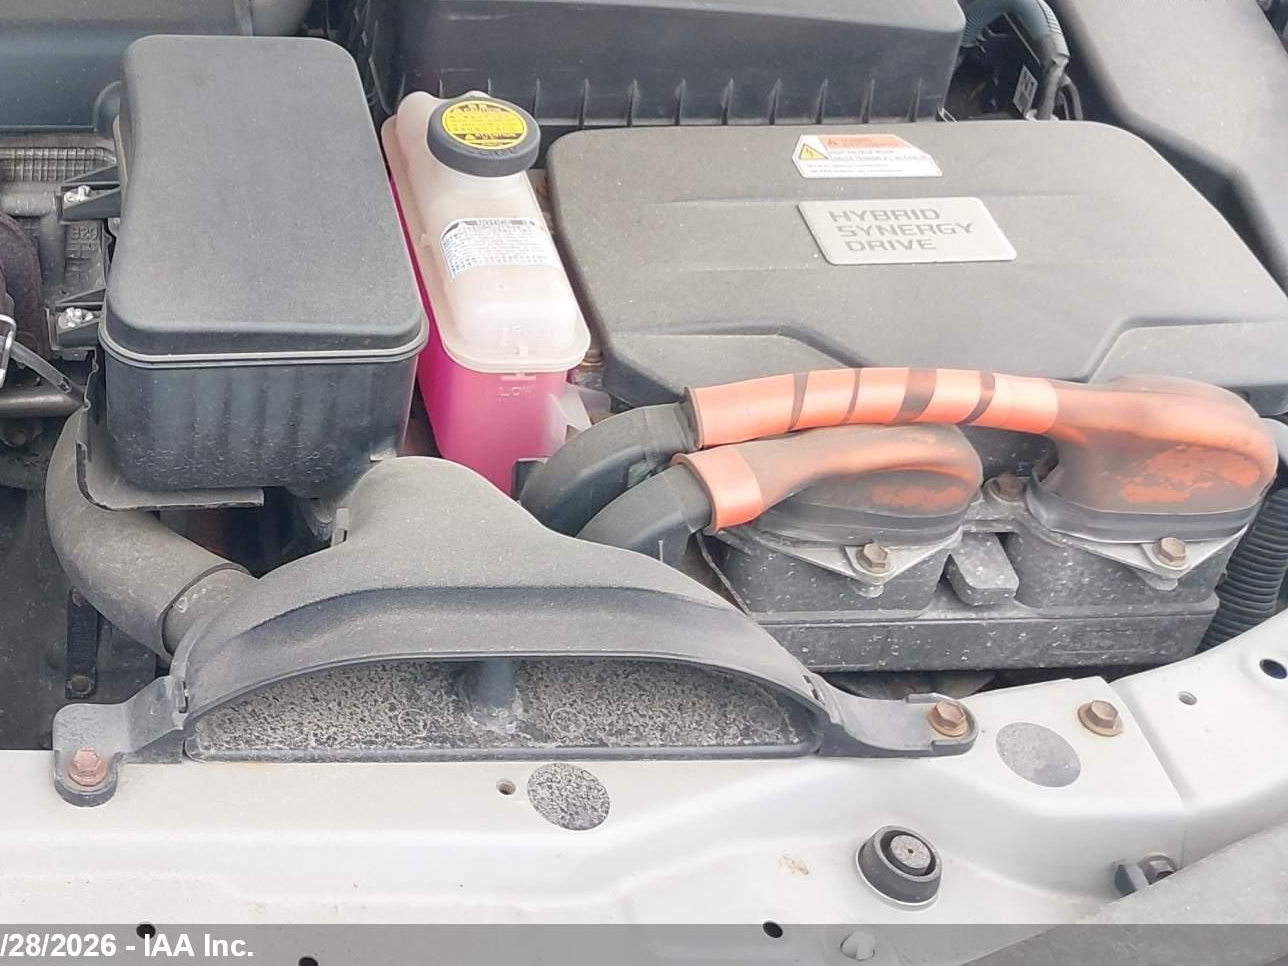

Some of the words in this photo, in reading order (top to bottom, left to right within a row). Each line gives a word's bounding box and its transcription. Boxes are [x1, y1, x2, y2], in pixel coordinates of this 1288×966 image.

[828, 208, 940, 223] HYBRID
[835, 222, 974, 237] SYNERGY
[844, 238, 937, 252] DRIVE
